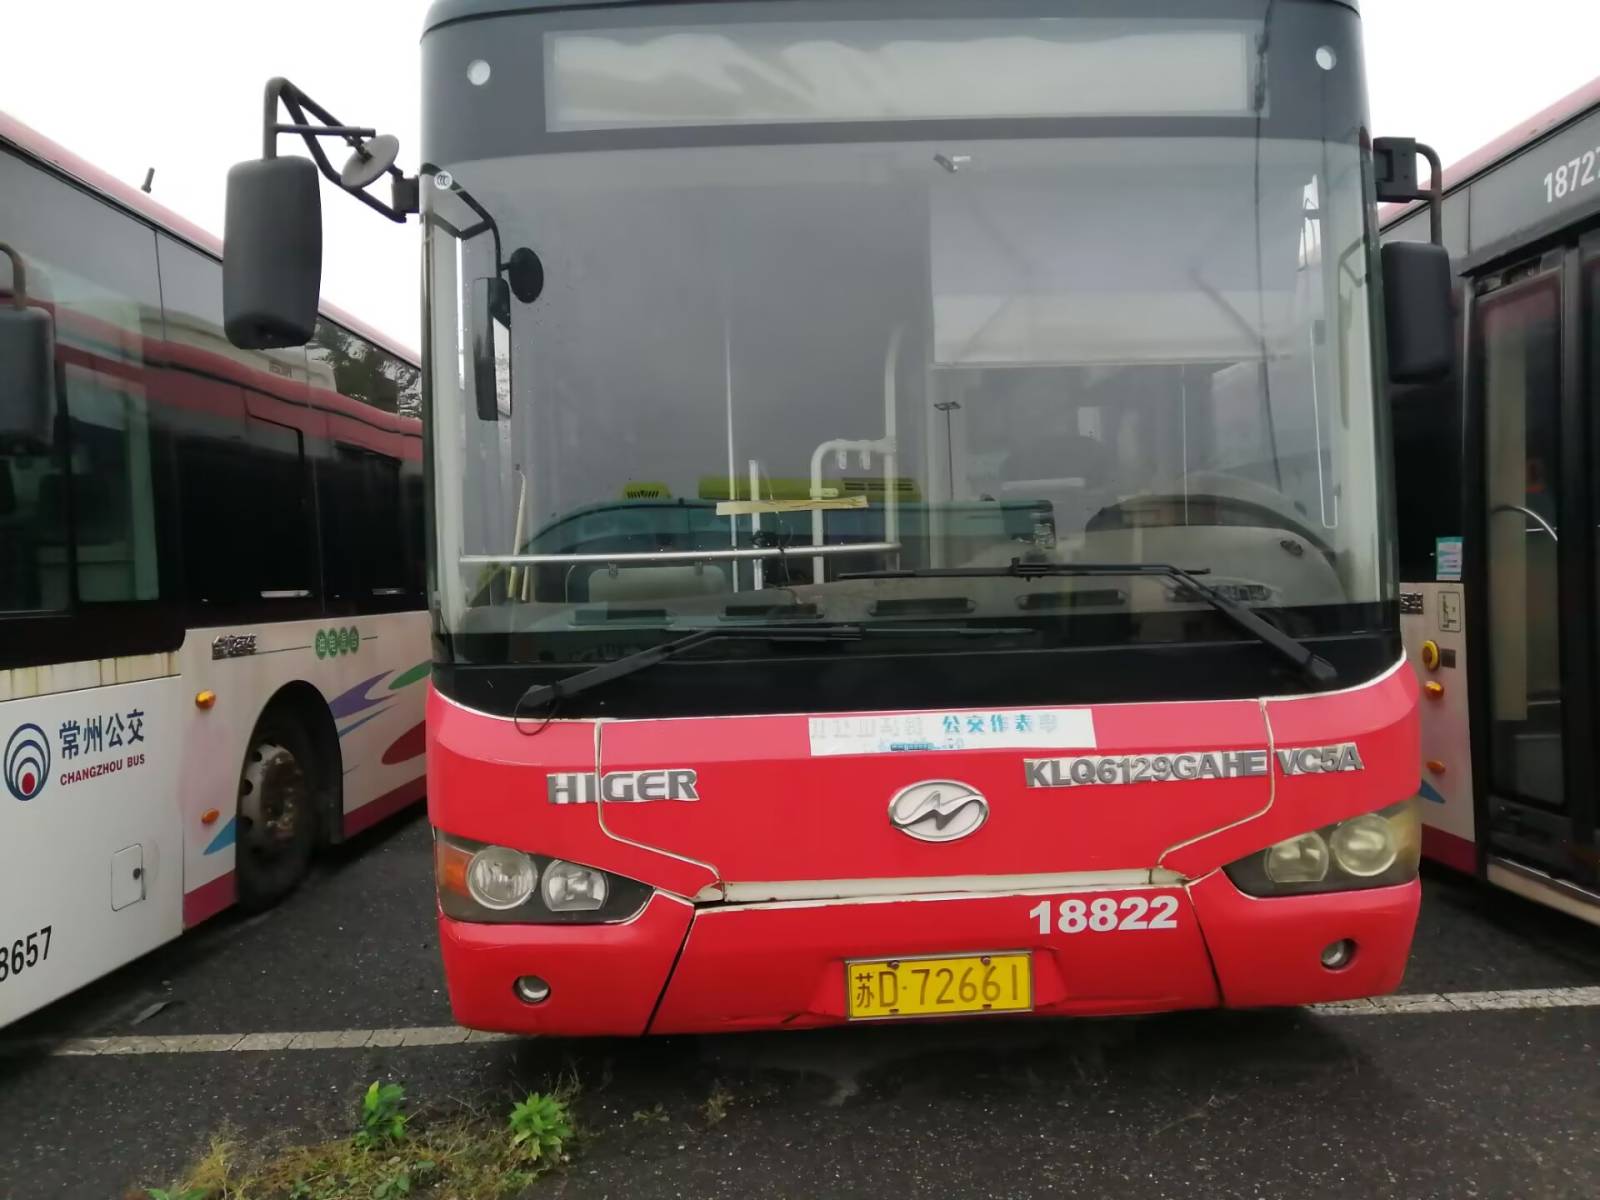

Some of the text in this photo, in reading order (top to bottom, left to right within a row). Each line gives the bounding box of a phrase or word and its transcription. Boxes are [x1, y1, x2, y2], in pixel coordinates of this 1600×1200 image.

[1543, 146, 1600, 203] 1872
[59, 708, 144, 760] 常州公交
[60, 753, 146, 786] CHANGZHOU BUS
[547, 769, 699, 804] HIGER
[1024, 743, 1364, 788] KLQ6129GAHE VC5A
[1029, 896, 1179, 935] 18822
